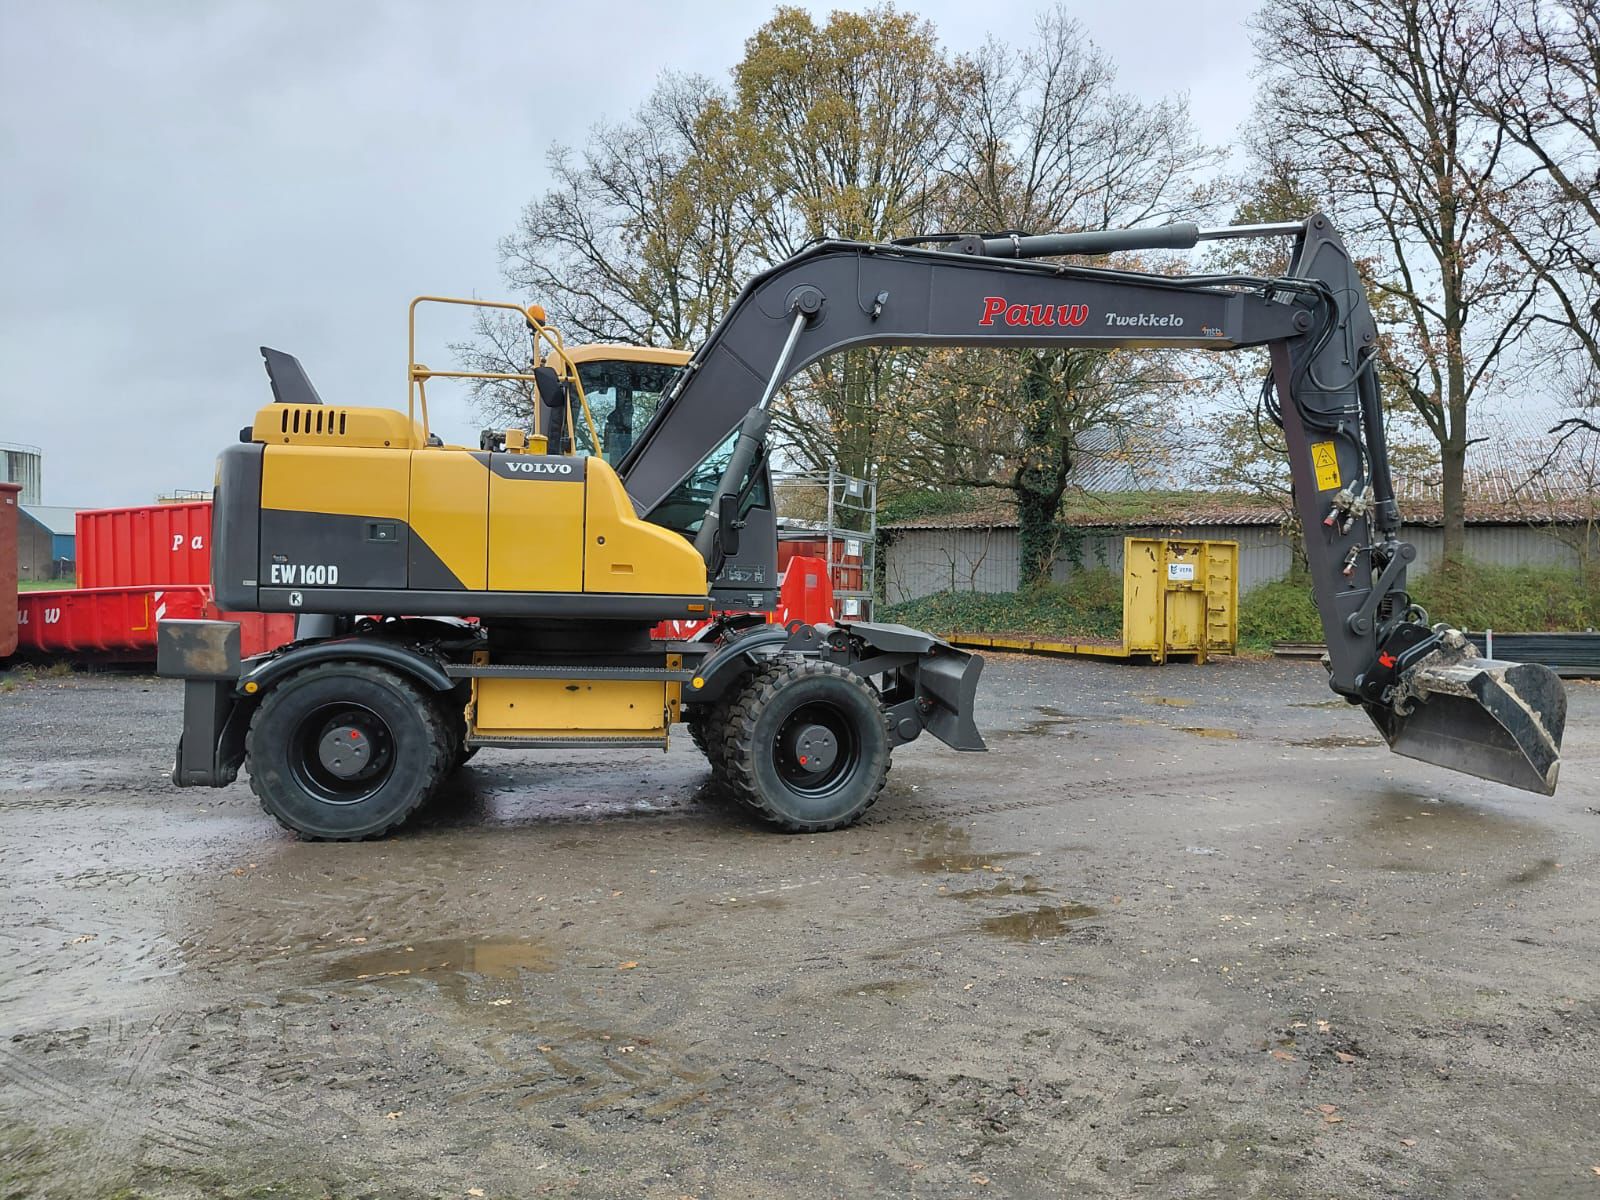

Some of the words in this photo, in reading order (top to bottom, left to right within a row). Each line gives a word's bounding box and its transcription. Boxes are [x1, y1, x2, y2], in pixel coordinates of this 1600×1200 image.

[979, 296, 1089, 327] Pauw
[1105, 312, 1184, 327] Twekkelo
[505, 462, 572, 474] VOLVO
